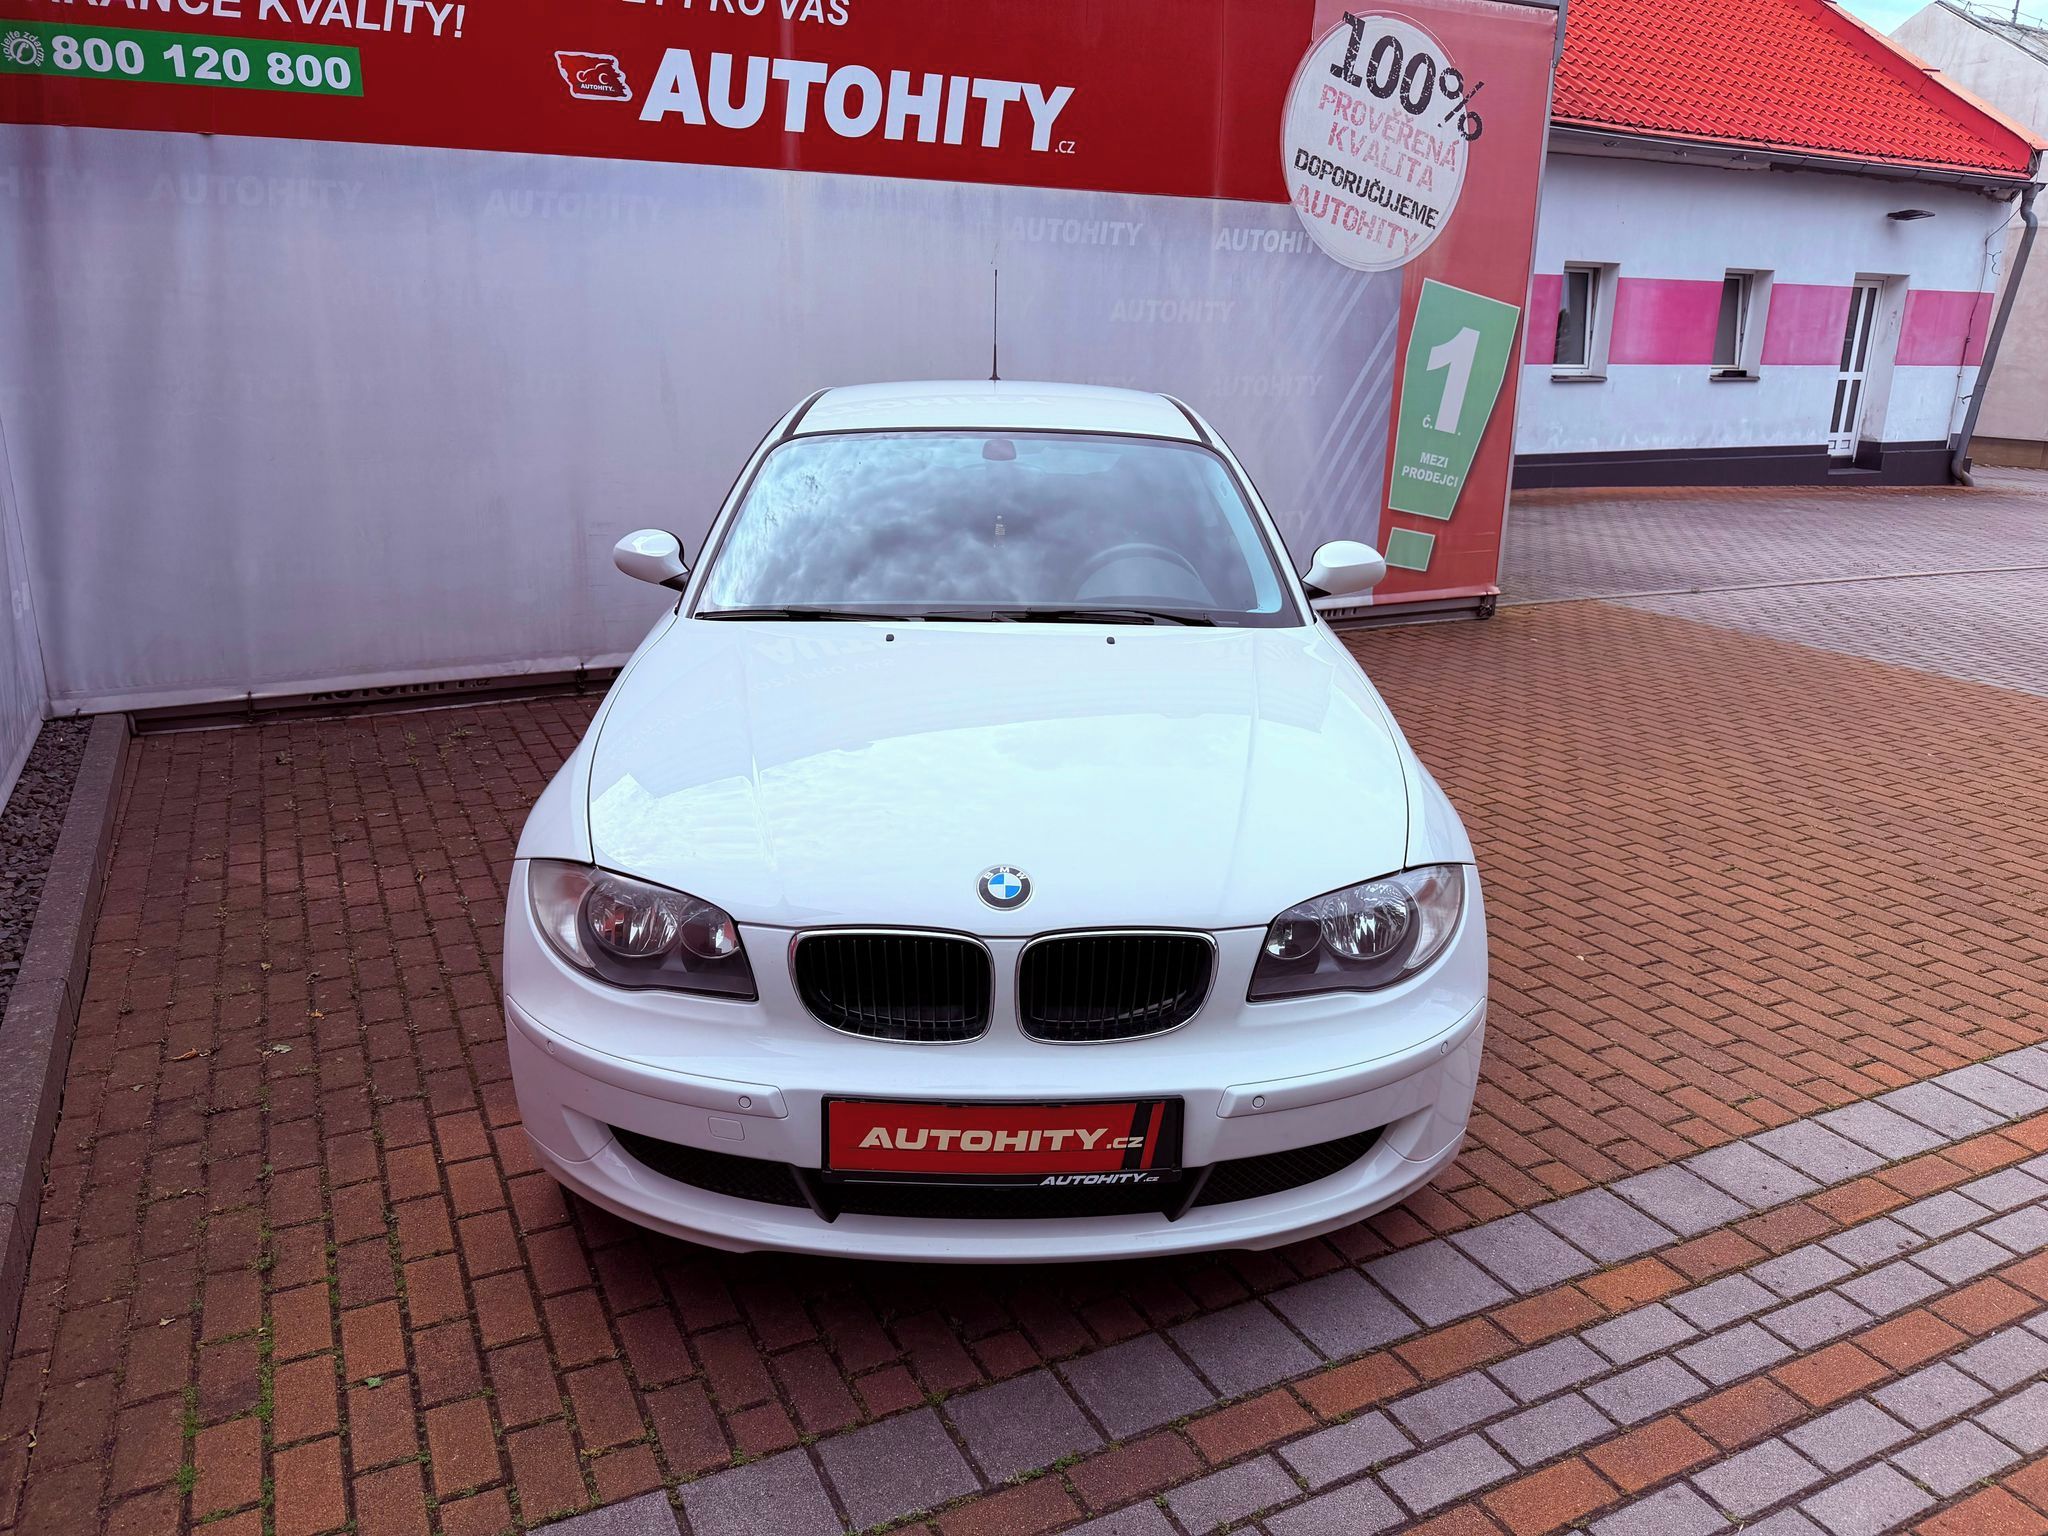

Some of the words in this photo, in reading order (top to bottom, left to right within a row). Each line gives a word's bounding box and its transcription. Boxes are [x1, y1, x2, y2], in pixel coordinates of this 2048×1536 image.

[258, 0, 465, 38] KVALITY!
[51, 35, 145, 75] 800
[163, 44, 250, 82] 120
[266, 52, 351, 90] 800
[1329, 11, 1485, 142] 100%
[1318, 84, 1460, 173] PROVĚŘENÁ
[1327, 121, 1434, 192] KVALITA
[1293, 148, 1440, 230] DOPORUČUJEME
[1010, 216, 1143, 246] AUTOHITY
[1295, 183, 1419, 256] AUTOHITY
[1109, 299, 1236, 323] AUTOHITY
[1401, 465, 1459, 488] PRODEJCI
[1419, 452, 1449, 469] MEZI
[984, 867, 1027, 879] BMW
